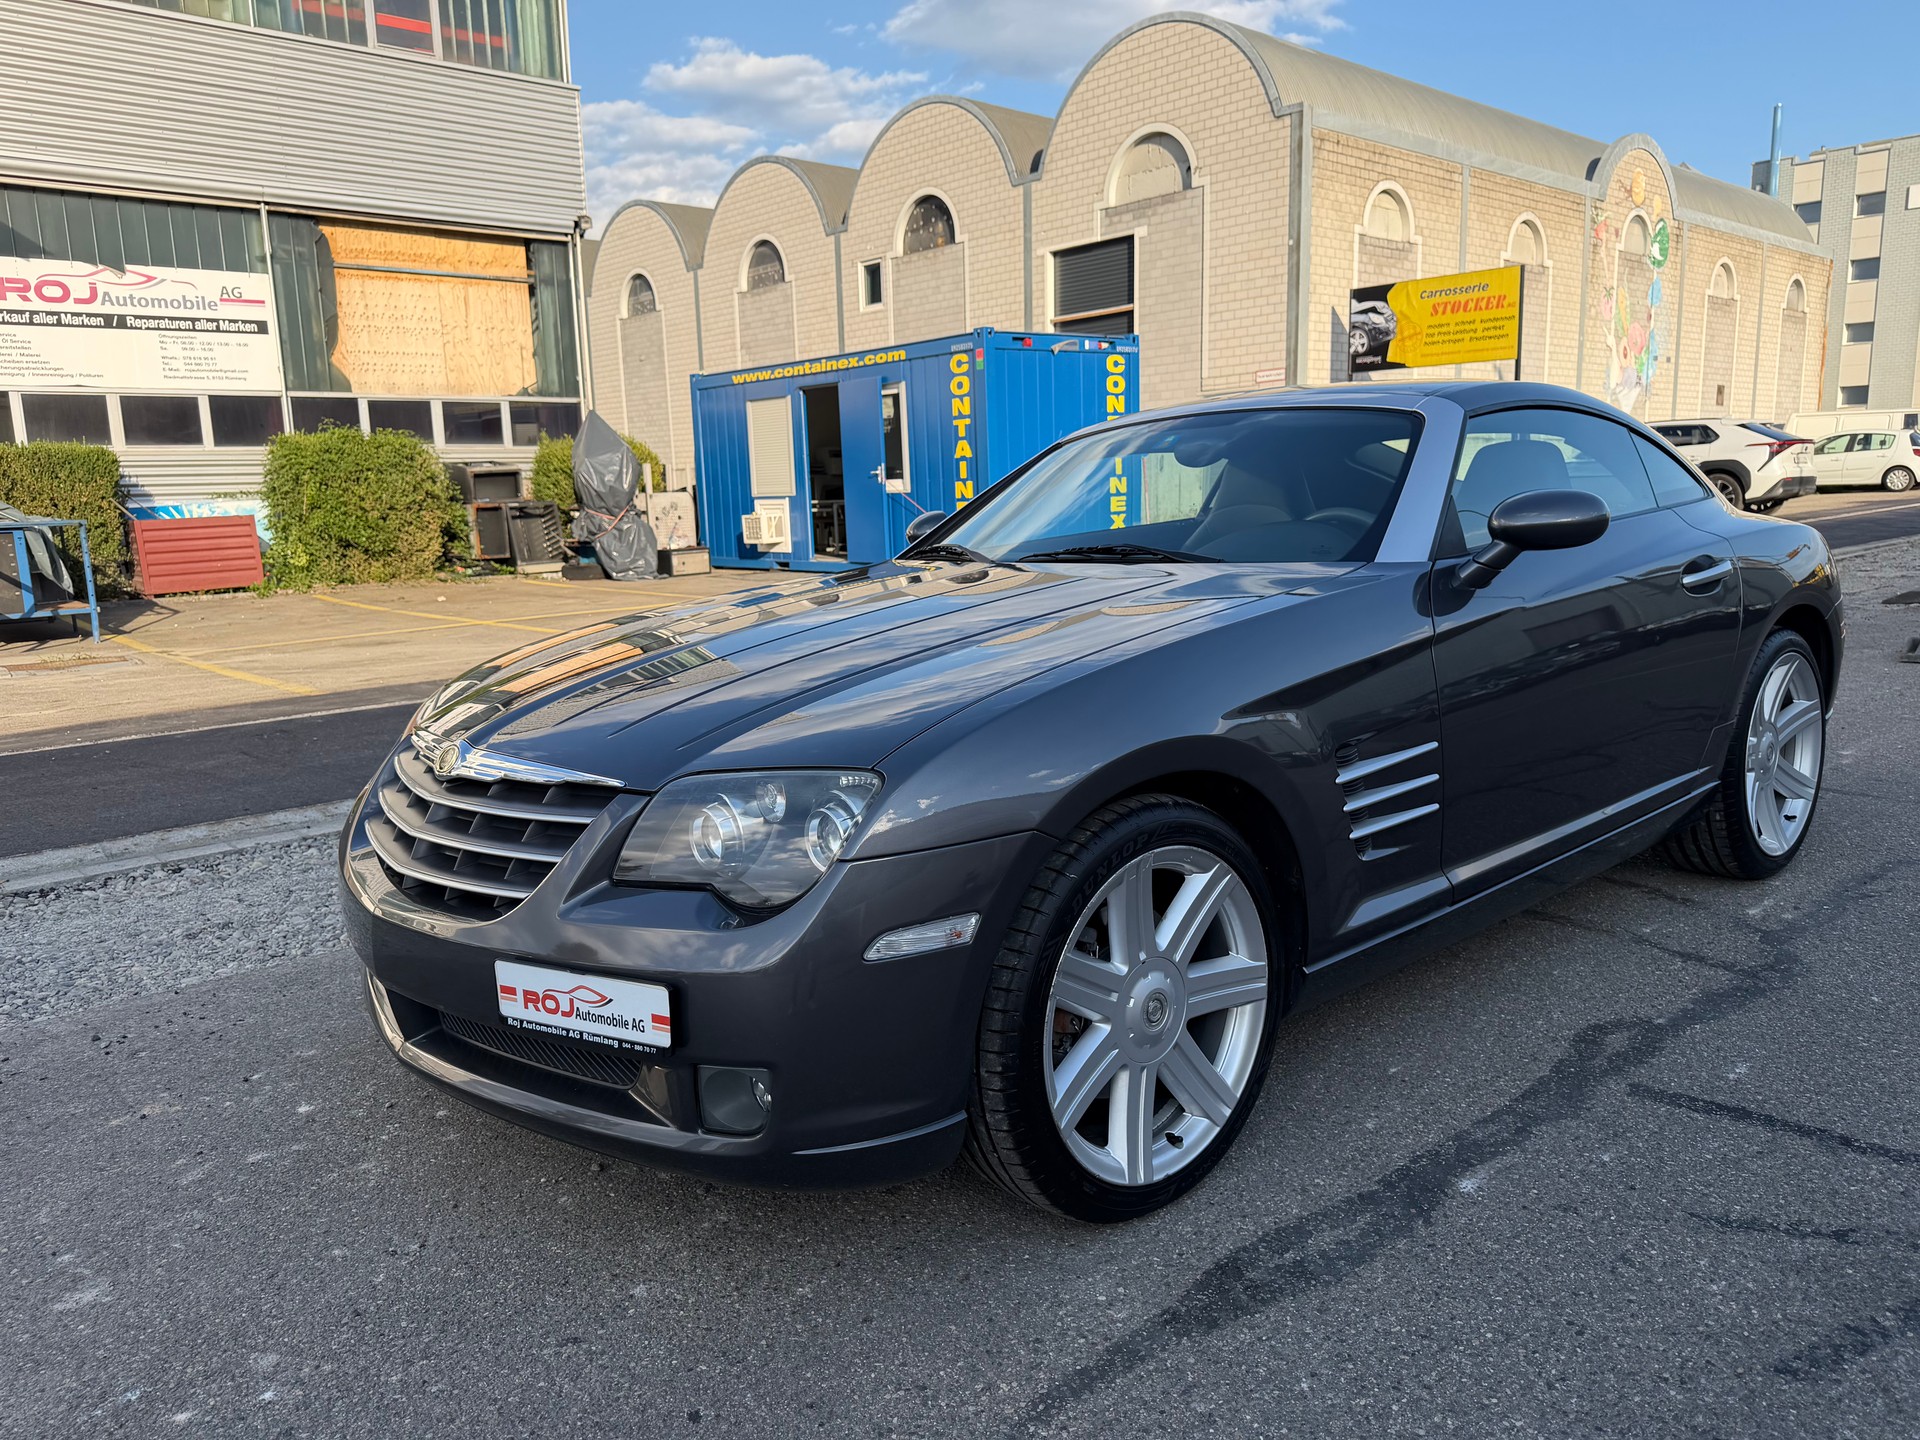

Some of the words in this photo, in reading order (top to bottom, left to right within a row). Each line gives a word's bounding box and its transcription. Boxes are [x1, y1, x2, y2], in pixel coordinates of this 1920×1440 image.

[0, 276, 98, 305] ROJ
[100, 291, 219, 312] Automobile
[220, 285, 243, 299] AG
[1419, 282, 1490, 301] Carrosserie
[1429, 294, 1508, 317] STOCKER
[33, 313, 58, 325] aller
[61, 313, 104, 327] Marken
[126, 316, 193, 331] Reparaturen
[195, 319, 218, 331] aller
[219, 320, 258, 333] Marken
[731, 348, 907, 385] www.containex.com
[949, 352, 975, 511] CONTAIN
[522, 988, 576, 1018] ROJ
[575, 1006, 629, 1030] Automobile
[631, 1017, 646, 1034] AG
[507, 1017, 521, 1029] Roj
[522, 1020, 567, 1037] Automobile
[568, 1030, 581, 1039] AG
[582, 1032, 620, 1049] Rümlang
[622, 1041, 631, 1049] 044
[651, 1047, 657, 1055] 77
